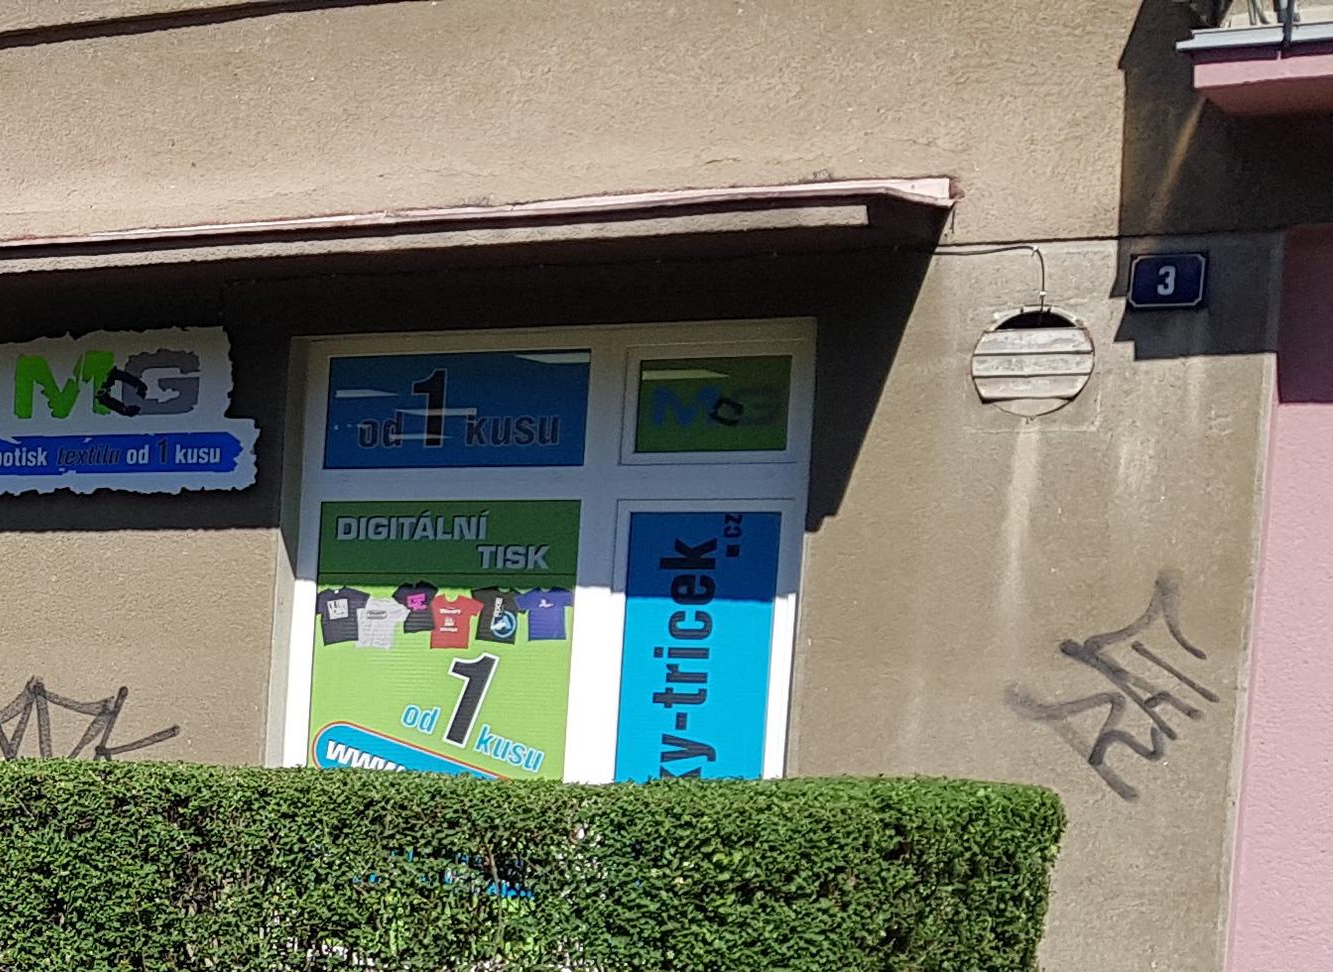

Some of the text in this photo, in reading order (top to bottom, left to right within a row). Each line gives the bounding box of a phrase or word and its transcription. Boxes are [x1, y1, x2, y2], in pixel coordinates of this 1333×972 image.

[1156, 266, 1177, 296] 3
[358, 368, 561, 449] od 1 kusu
[56, 444, 122, 466] textilu
[126, 444, 150, 465] od
[156, 437, 169, 464] 1
[175, 444, 221, 464] kusu
[336, 510, 489, 541] DIGITÁLNÍ
[478, 545, 550, 570] TISK
[401, 652, 546, 774] od 1 kusu
